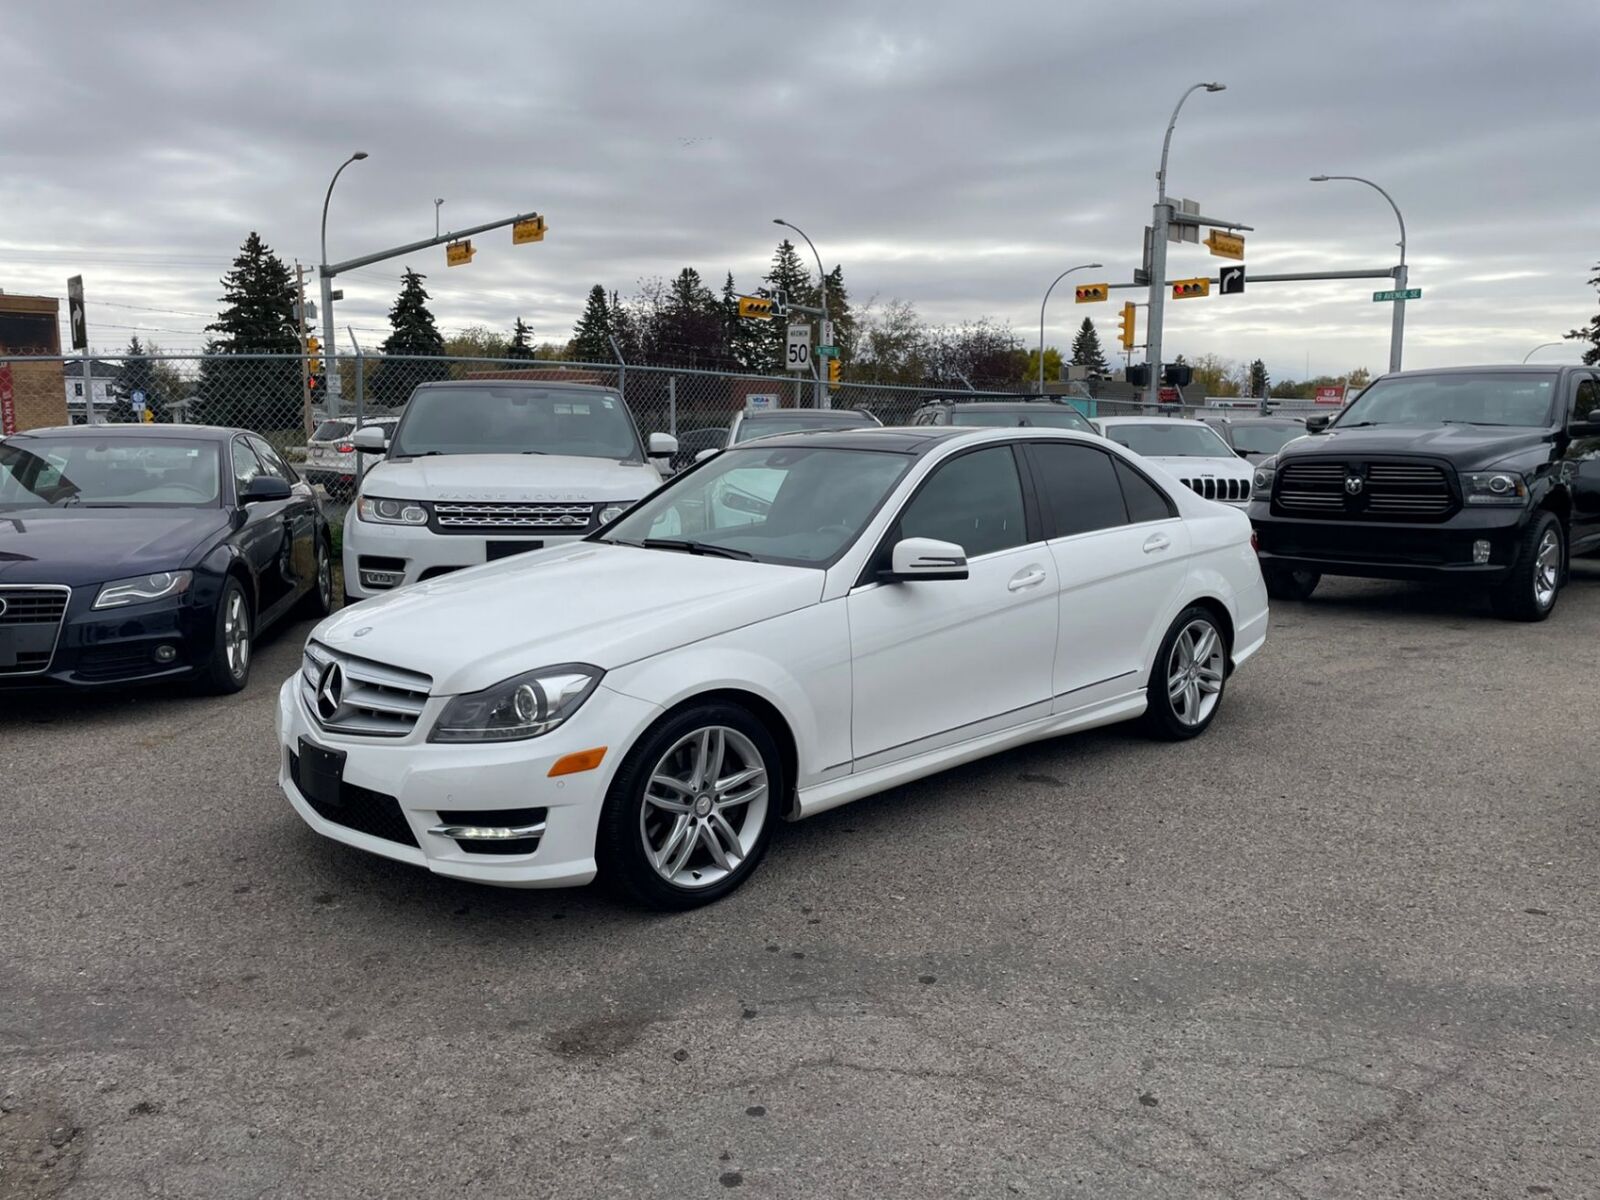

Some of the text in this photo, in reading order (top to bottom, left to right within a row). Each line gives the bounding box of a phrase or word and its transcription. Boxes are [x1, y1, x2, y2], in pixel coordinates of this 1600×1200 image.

[1384, 290, 1408, 300] AVENUE
[1409, 289, 1420, 298] SE
[789, 343, 808, 363] 50
